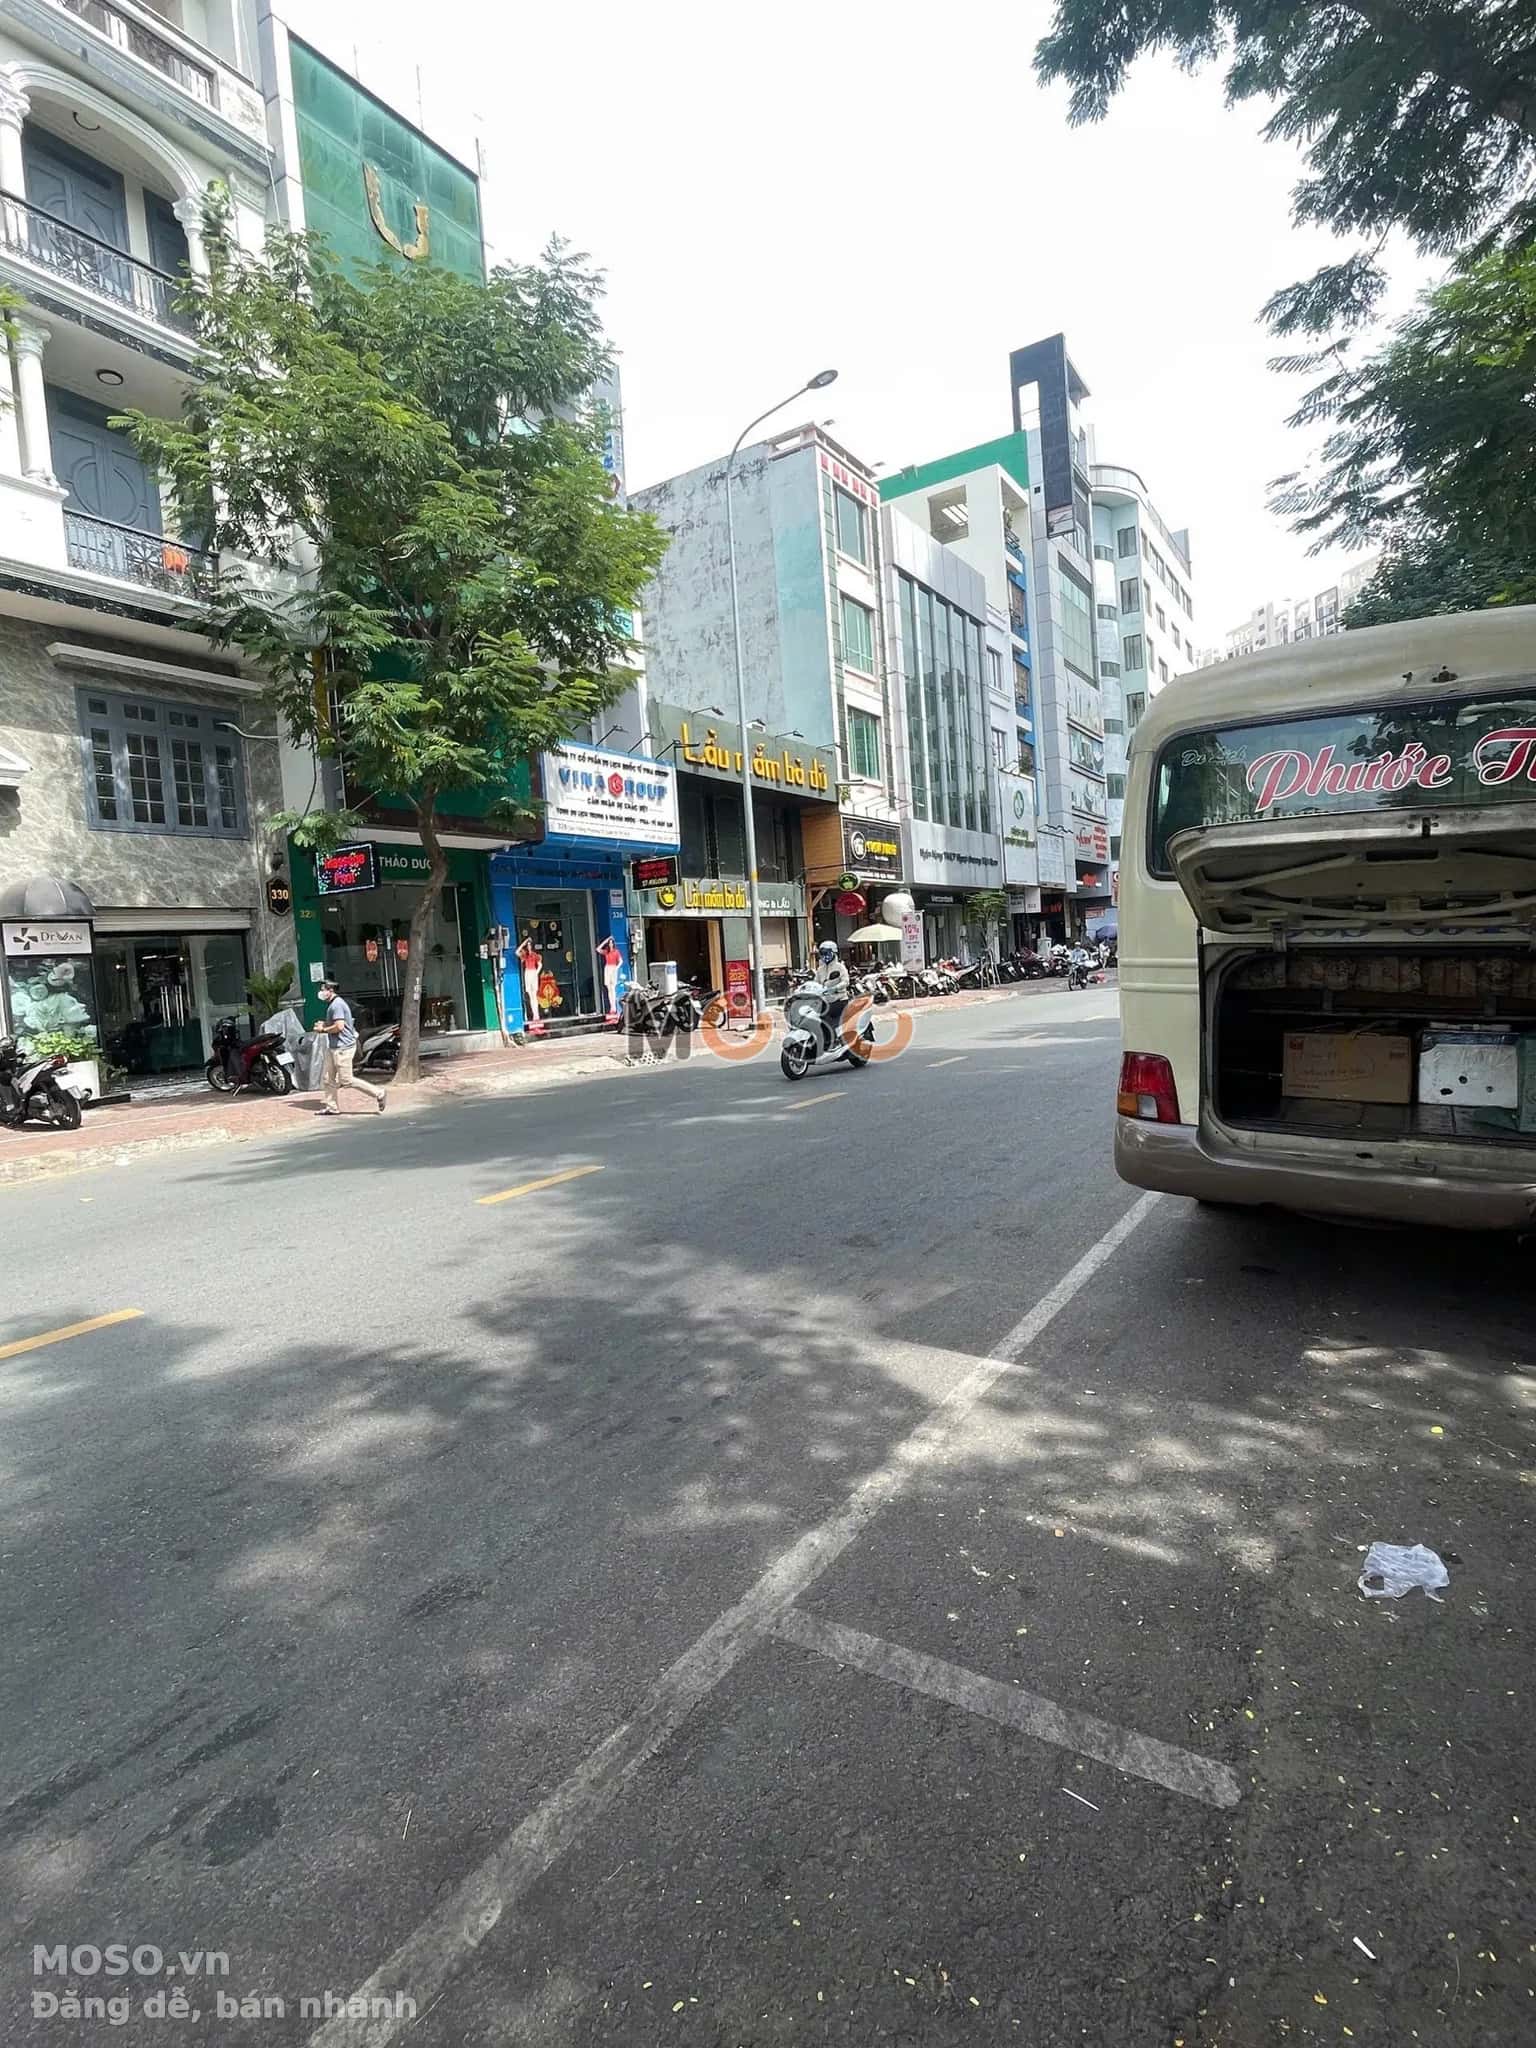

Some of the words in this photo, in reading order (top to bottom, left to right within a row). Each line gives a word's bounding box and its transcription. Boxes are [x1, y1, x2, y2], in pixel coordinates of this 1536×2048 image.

[1245, 743, 1454, 813] Phước
[1473, 727, 1536, 787] T
[379, 852, 408, 868] THẢO
[271, 889, 289, 900] 330
